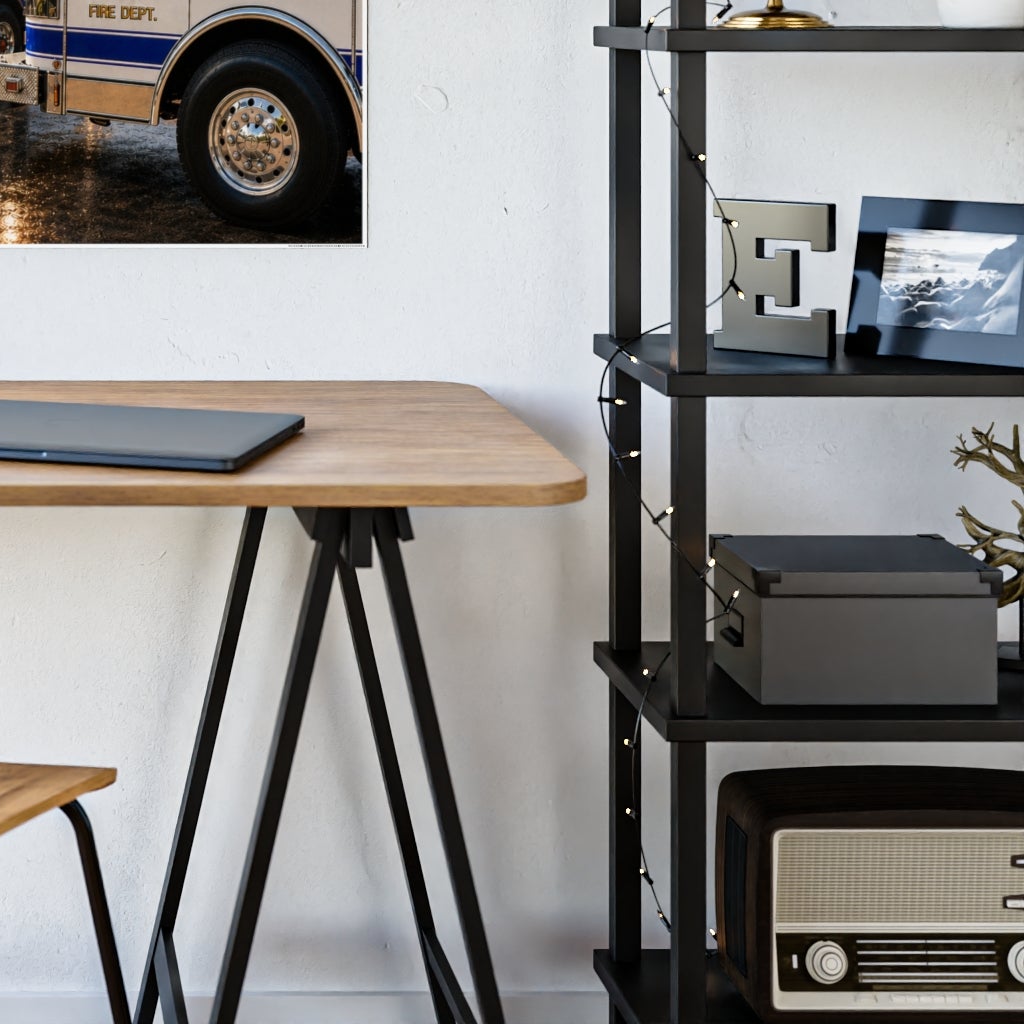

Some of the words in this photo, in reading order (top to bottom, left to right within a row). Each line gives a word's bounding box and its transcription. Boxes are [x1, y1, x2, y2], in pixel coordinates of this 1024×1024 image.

[89, 4, 116, 19] FIRE
[120, 5, 158, 22] DEPT.
[714, 198, 836, 360] E
